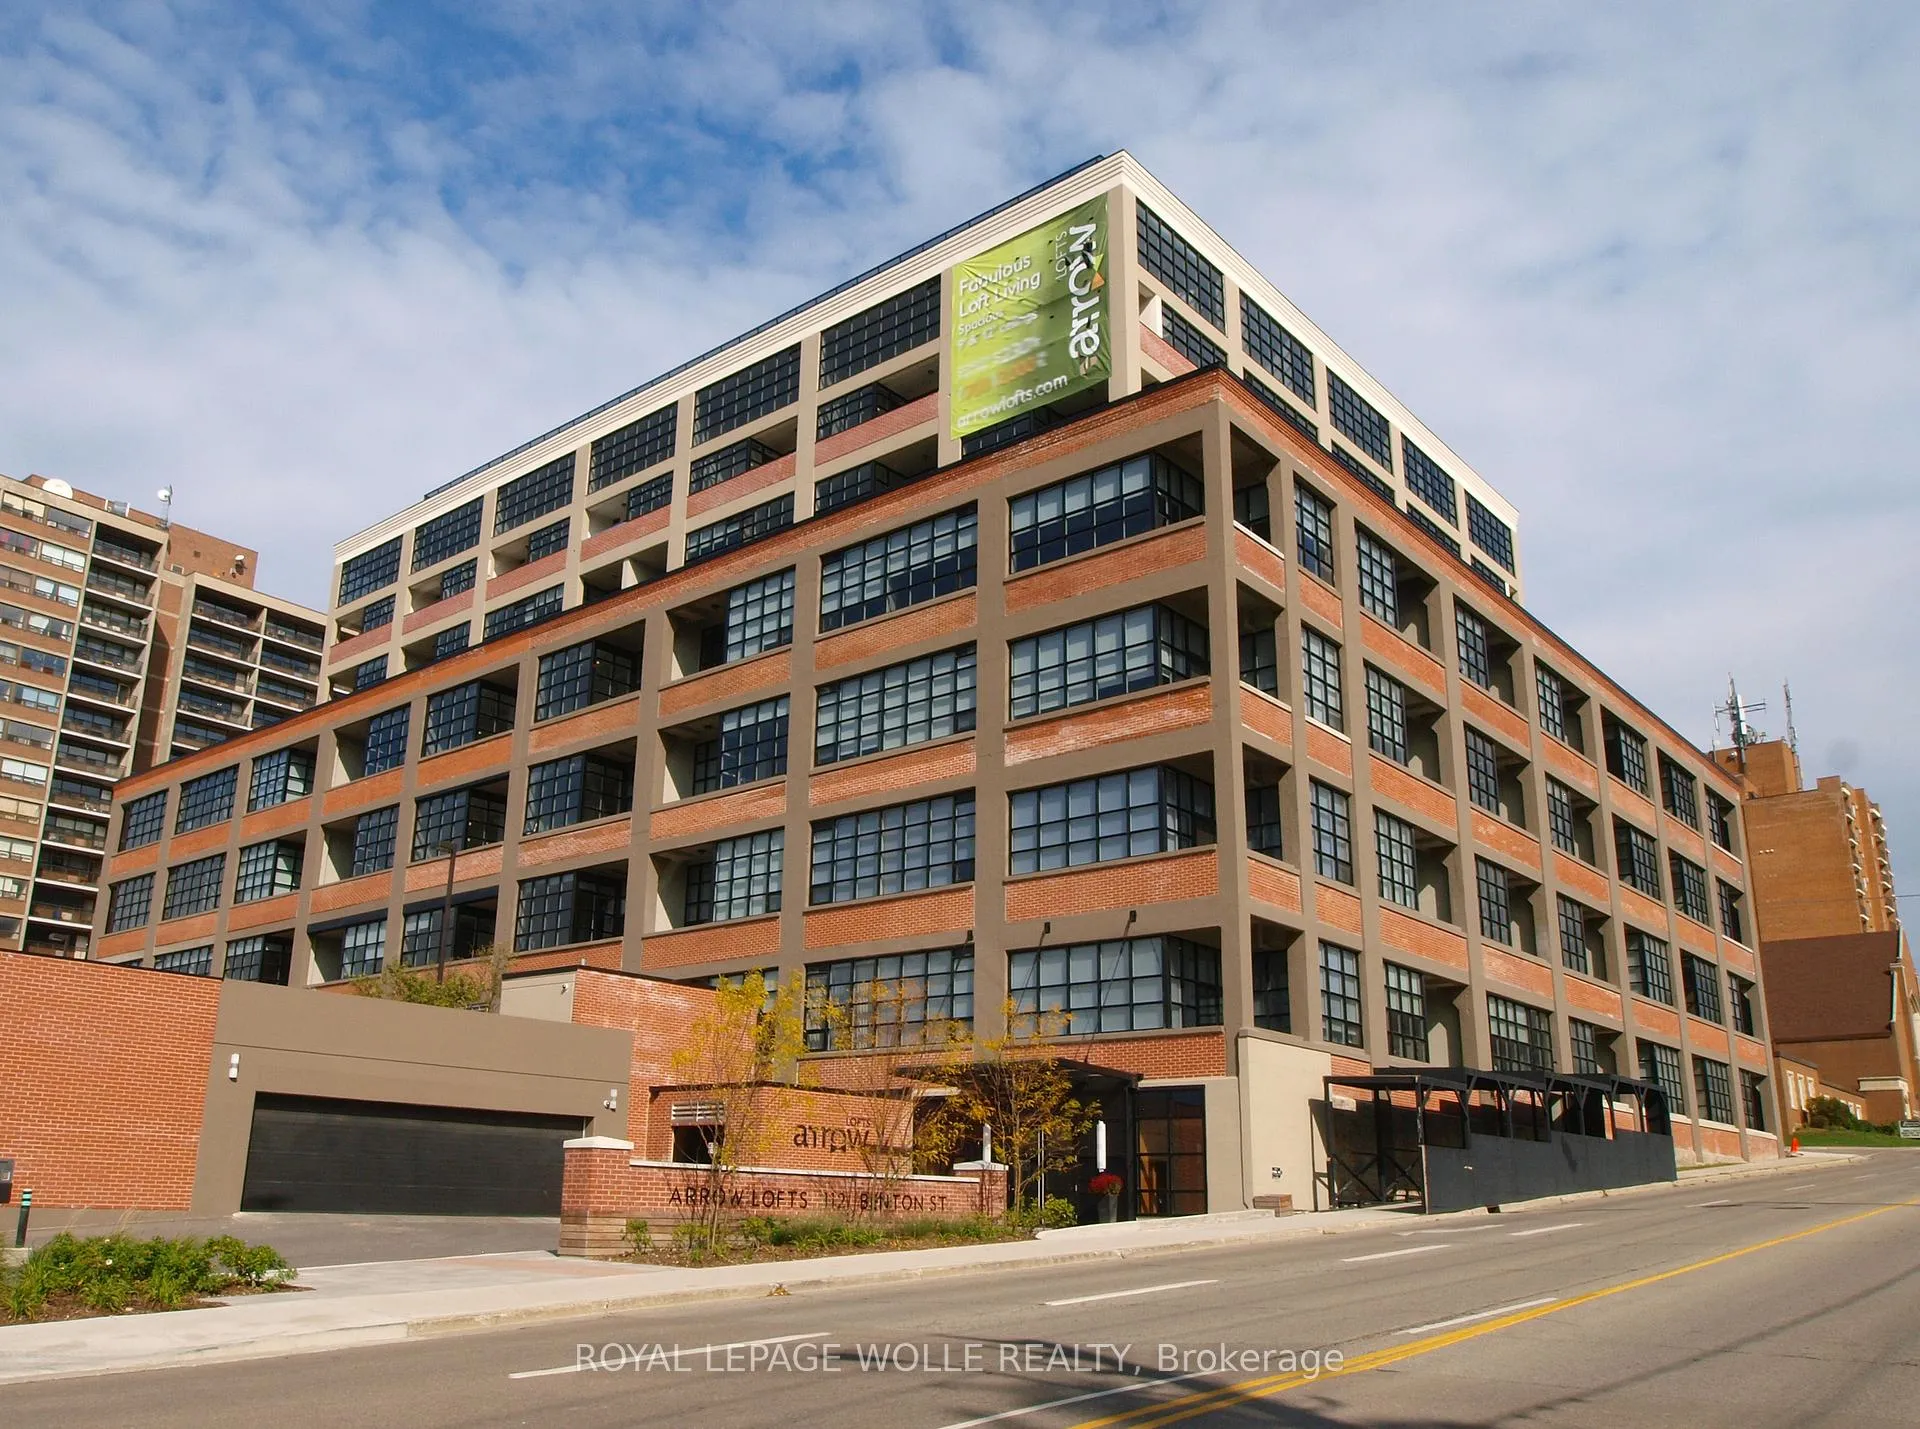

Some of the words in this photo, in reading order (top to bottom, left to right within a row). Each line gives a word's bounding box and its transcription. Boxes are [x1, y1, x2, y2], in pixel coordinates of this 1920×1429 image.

[959, 255, 1032, 297] Fabulous
[1055, 231, 1067, 281] LOFTS
[959, 293, 990, 318] Loft
[994, 271, 1041, 303] Living
[1068, 222, 1101, 359] arrow
[957, 374, 1069, 429] arrowlofts.com
[793, 1124, 870, 1151] arrow
[845, 1116, 871, 1128] LOFTS
[668, 1186, 744, 1206] ARROW
[751, 1190, 808, 1209] LOFTS
[929, 1195, 947, 1212] ST
